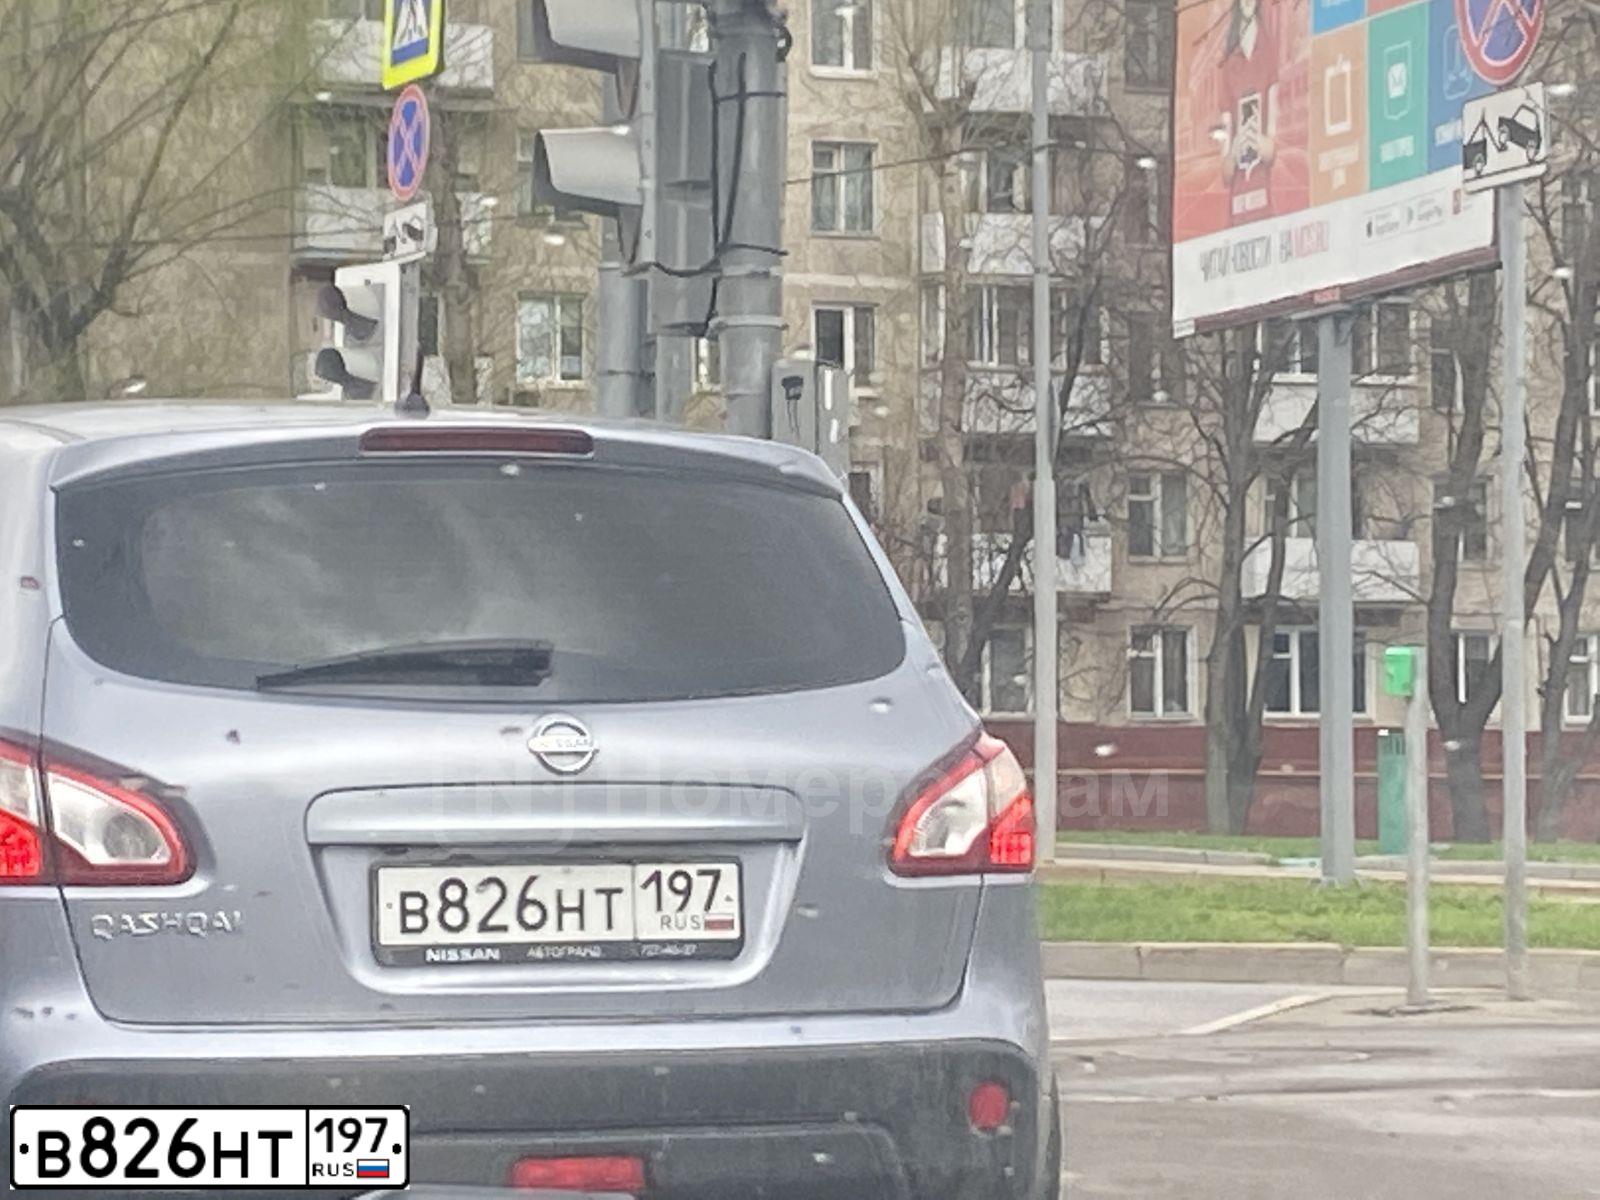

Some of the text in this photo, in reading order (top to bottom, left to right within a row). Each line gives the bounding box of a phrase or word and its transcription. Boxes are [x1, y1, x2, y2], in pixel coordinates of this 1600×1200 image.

[398, 868, 722, 935] В826НТ 197
[660, 914, 702, 931] RUS
[425, 948, 500, 962] NISSAN
